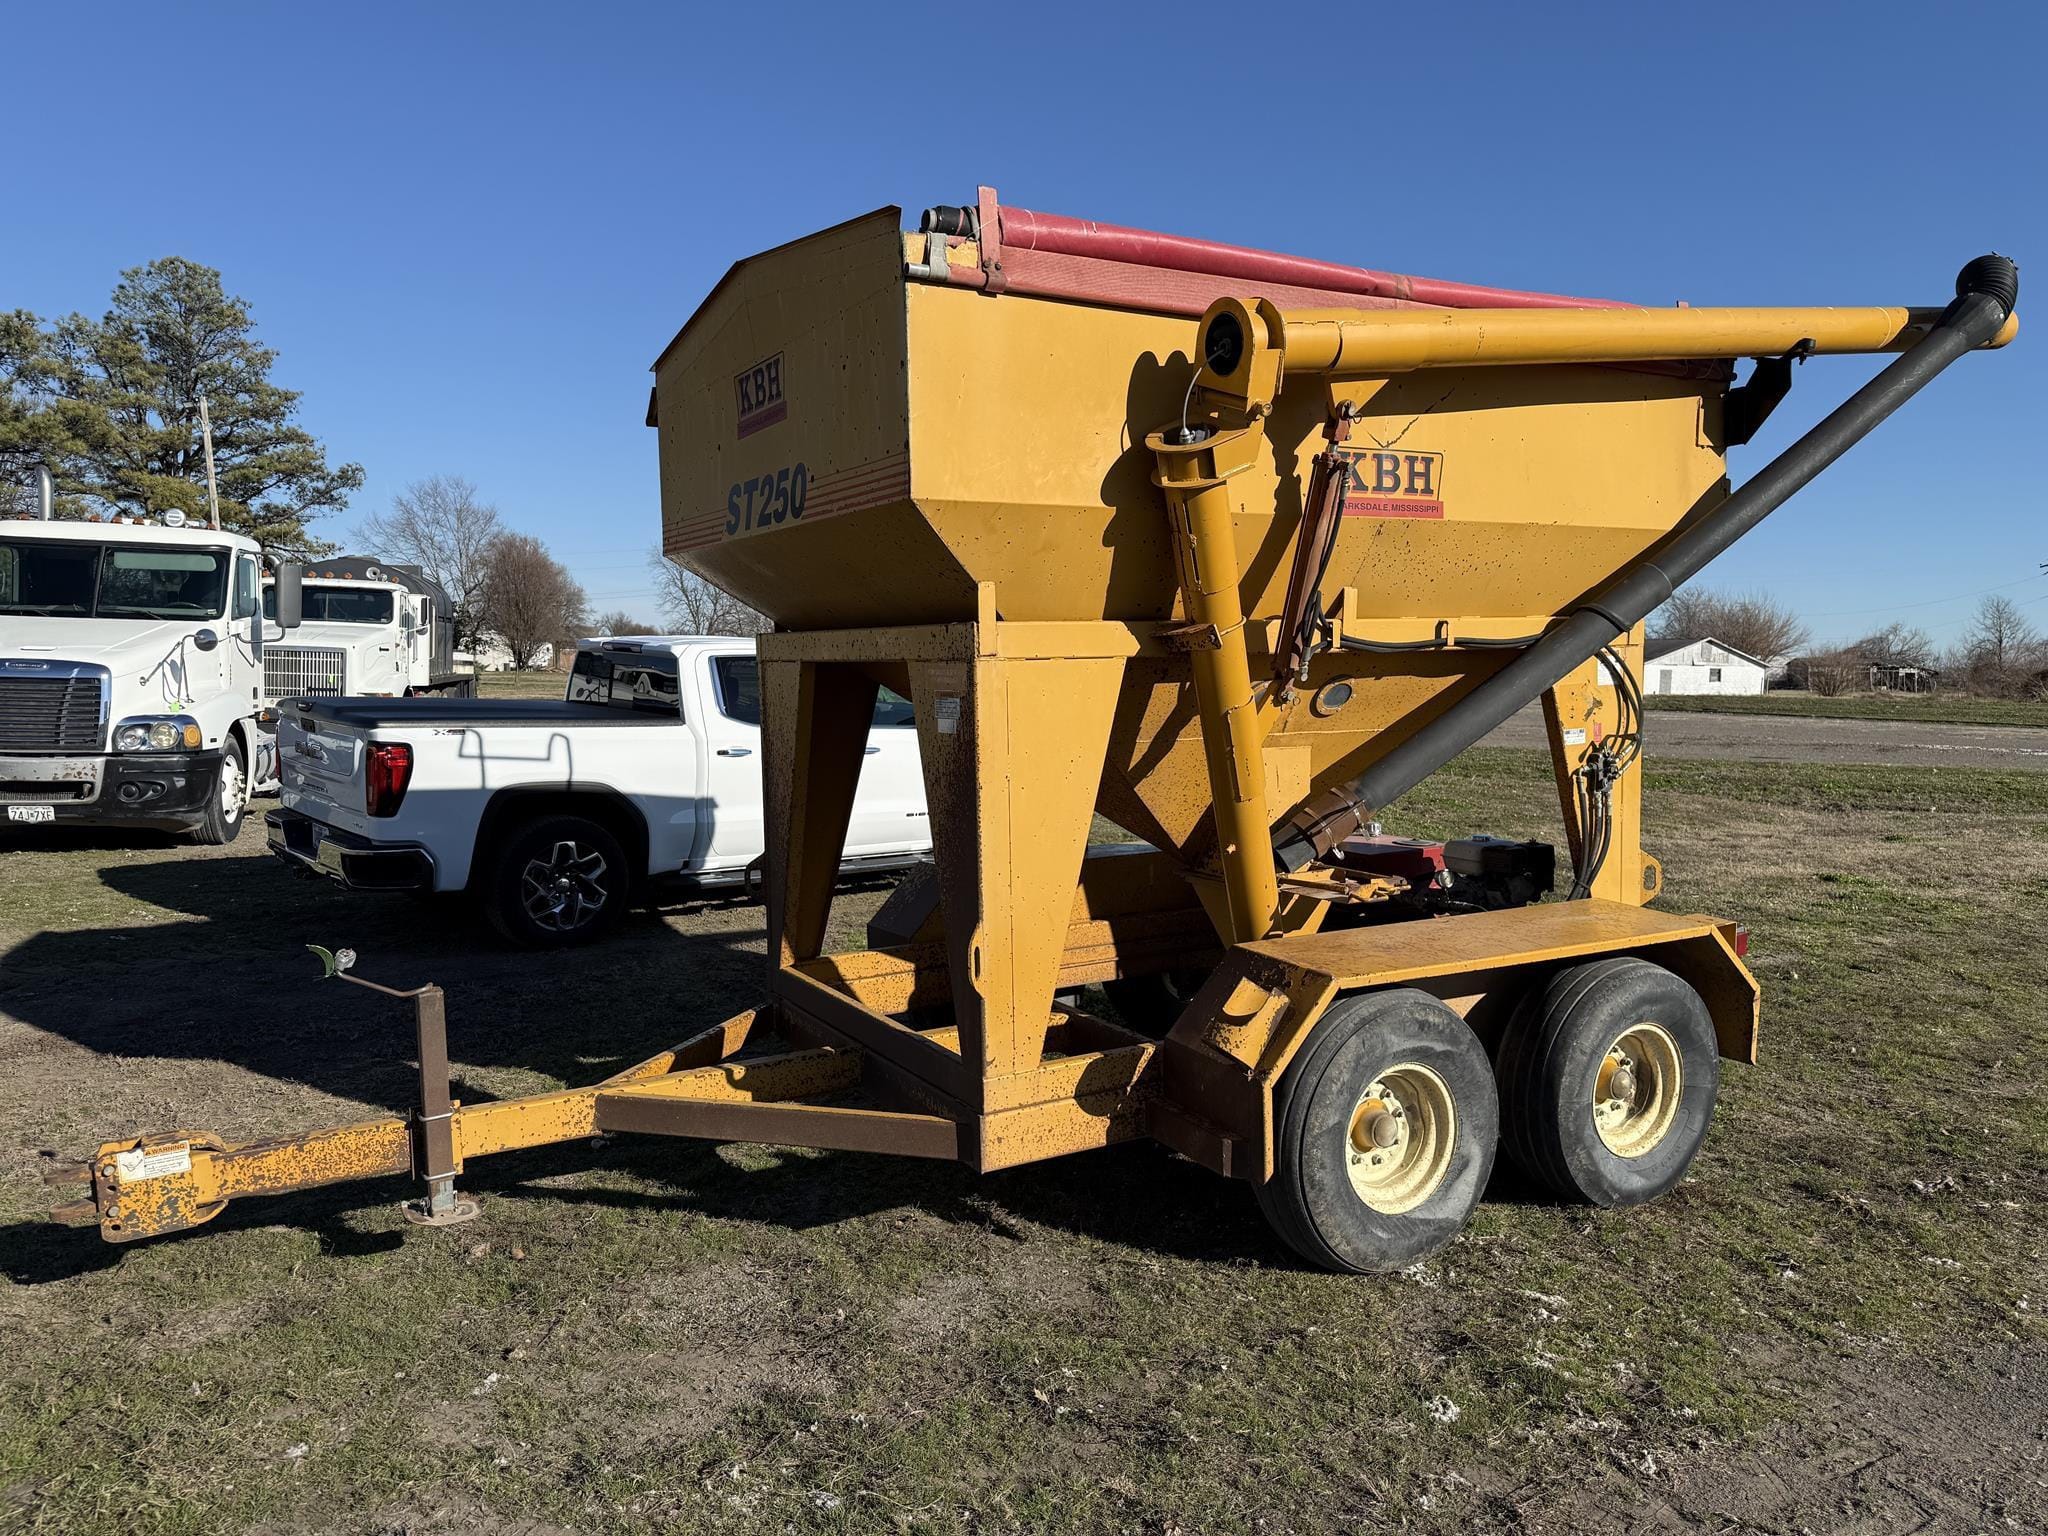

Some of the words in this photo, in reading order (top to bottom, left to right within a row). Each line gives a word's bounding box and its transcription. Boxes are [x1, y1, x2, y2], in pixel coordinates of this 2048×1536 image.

[738, 357, 782, 416] KBH
[1338, 451, 1435, 496] KBH
[726, 462, 807, 536] ST250
[1392, 503, 1439, 513] MISSISSIPPI
[152, 1143, 185, 1154] WARNING
